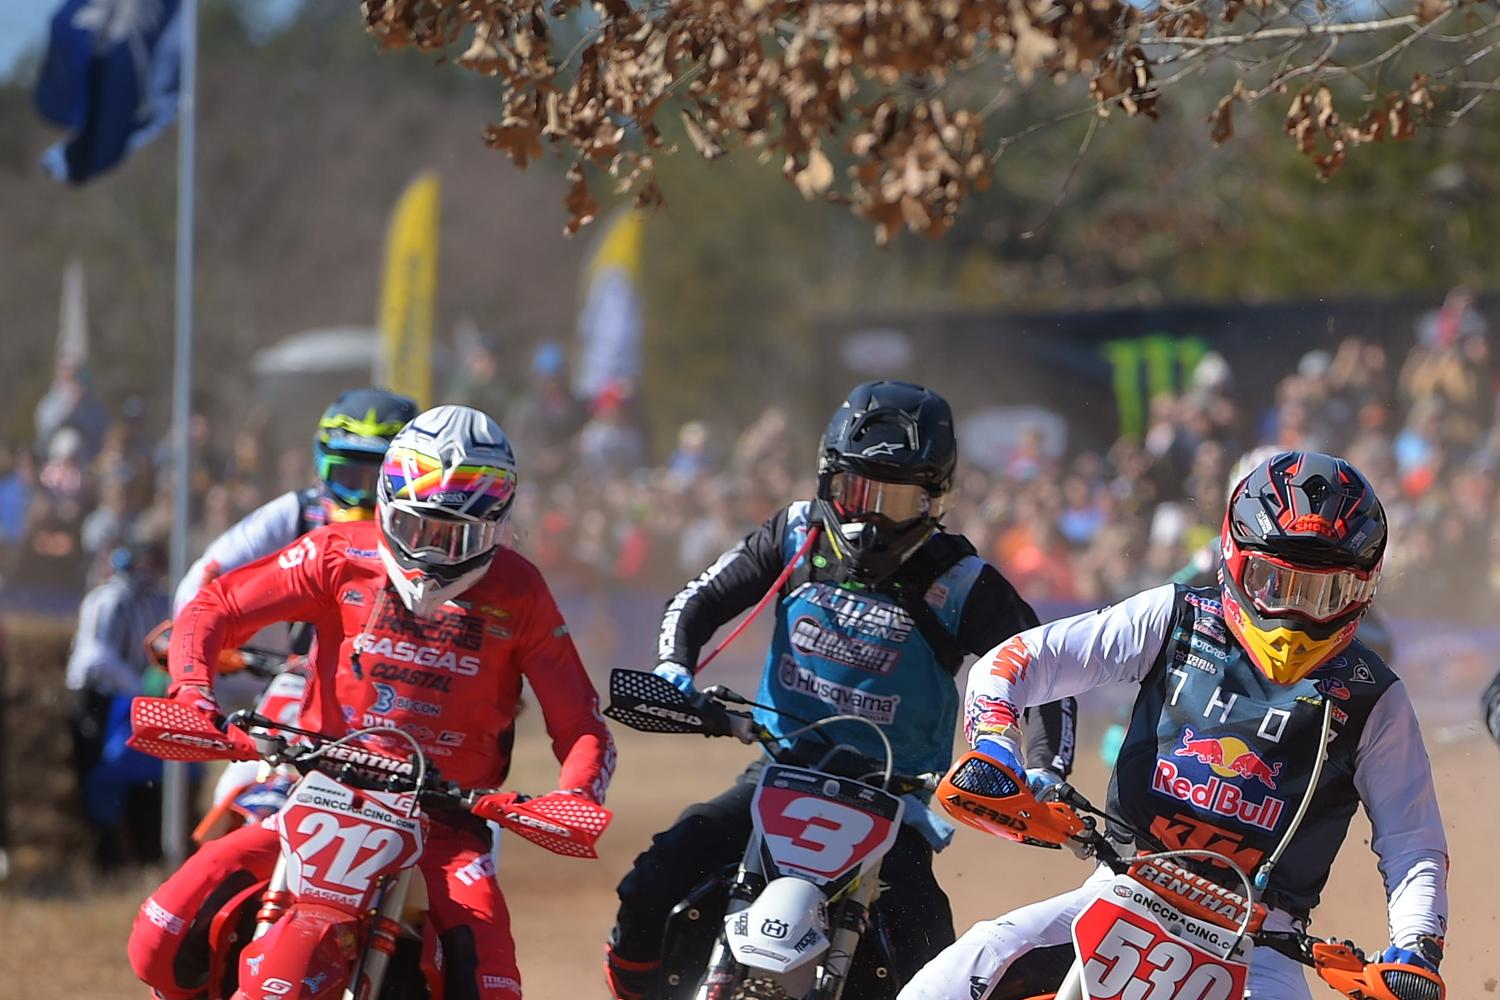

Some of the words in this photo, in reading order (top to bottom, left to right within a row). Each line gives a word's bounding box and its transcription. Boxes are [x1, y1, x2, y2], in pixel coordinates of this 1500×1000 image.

[353, 632, 481, 676] GASGAS
[370, 663, 453, 692] COASTAL
[797, 674, 893, 713] Husqvarna
[321, 743, 414, 776] RENTHA
[314, 795, 416, 831] GNCCCING.COM
[946, 794, 1028, 832] ACERBIS
[1152, 758, 1219, 811] Red
[1213, 781, 1285, 832] Bull
[296, 811, 404, 891] 212
[766, 796, 875, 873] 3
[1150, 813, 1264, 876] KTM
